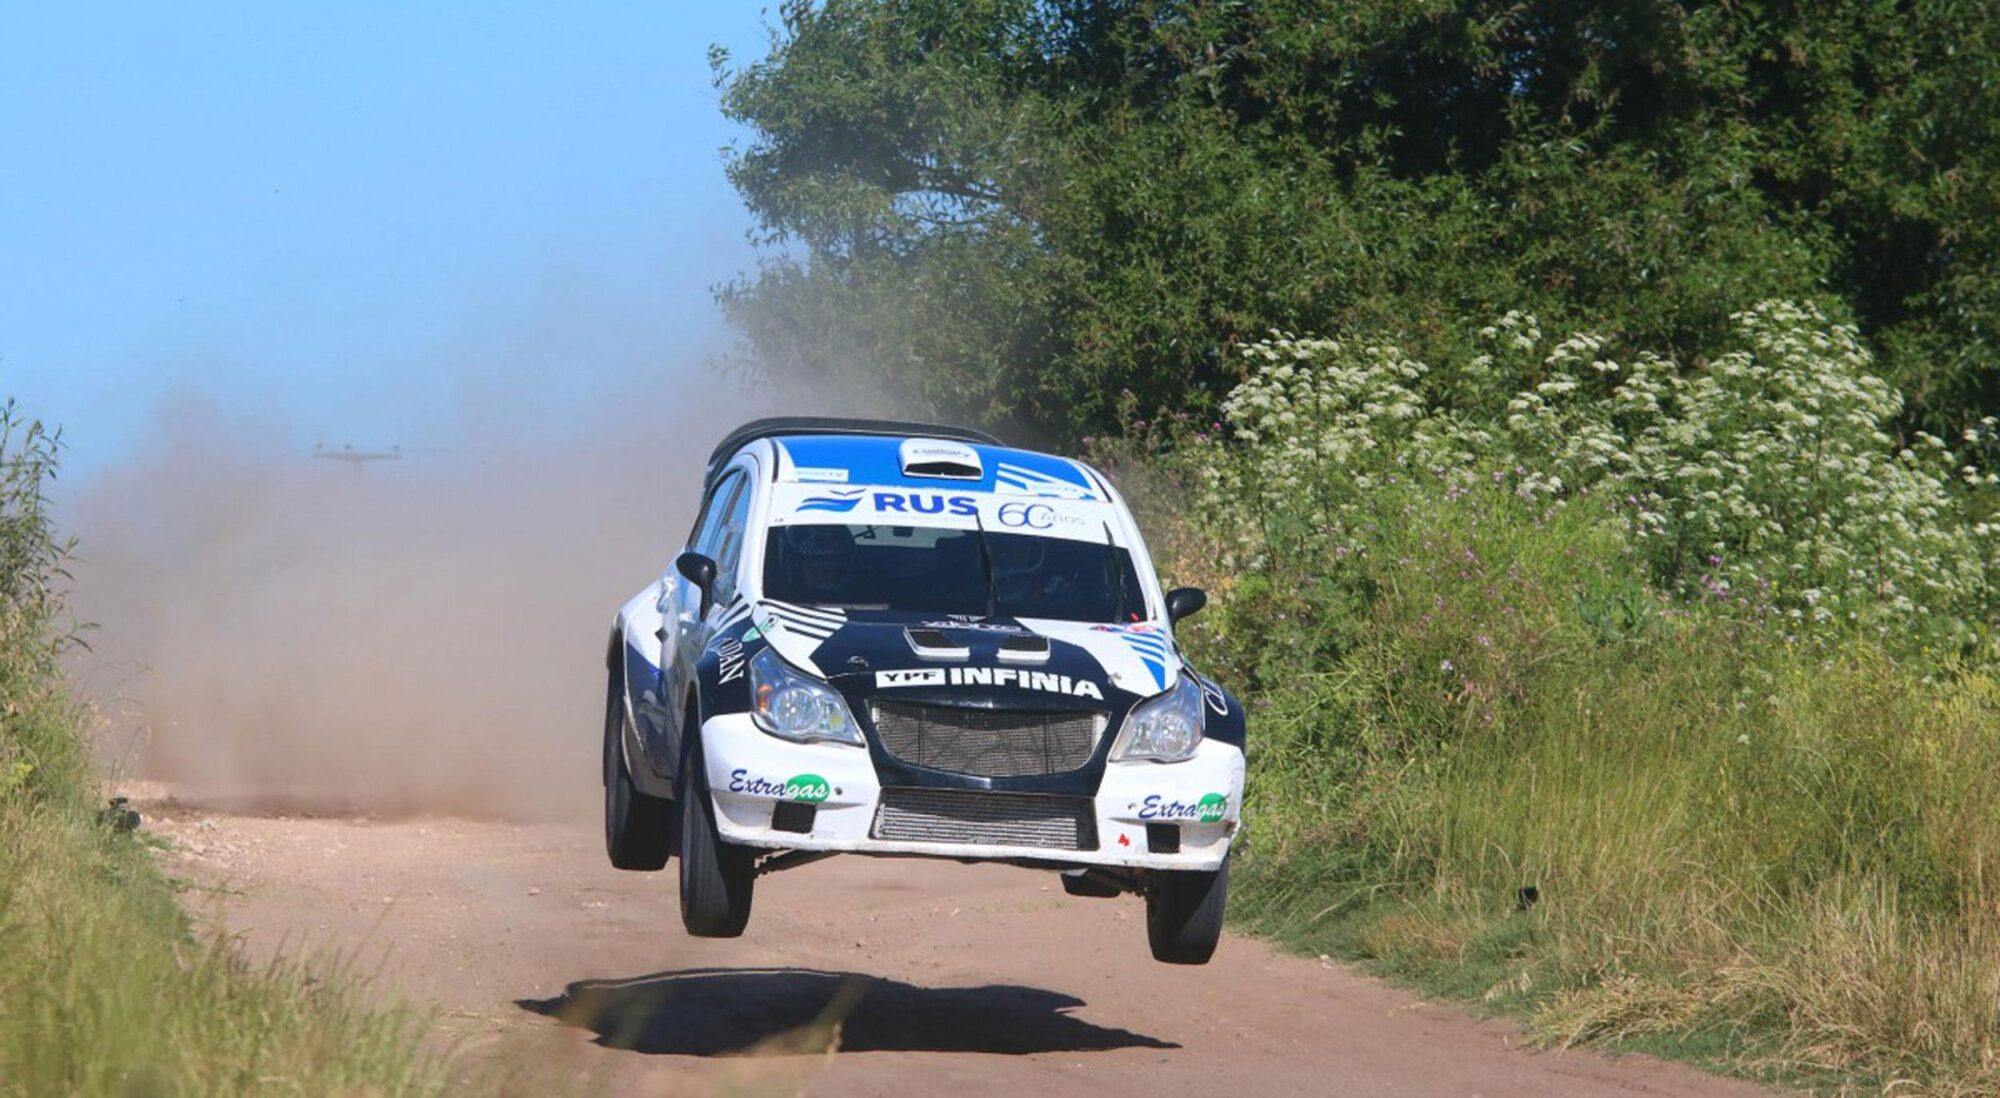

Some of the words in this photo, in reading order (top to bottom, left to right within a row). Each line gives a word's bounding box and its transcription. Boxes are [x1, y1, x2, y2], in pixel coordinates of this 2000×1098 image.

[873, 493, 978, 516] RUS
[884, 672, 938, 681] YPF
[951, 667, 1104, 700] INFINIA
